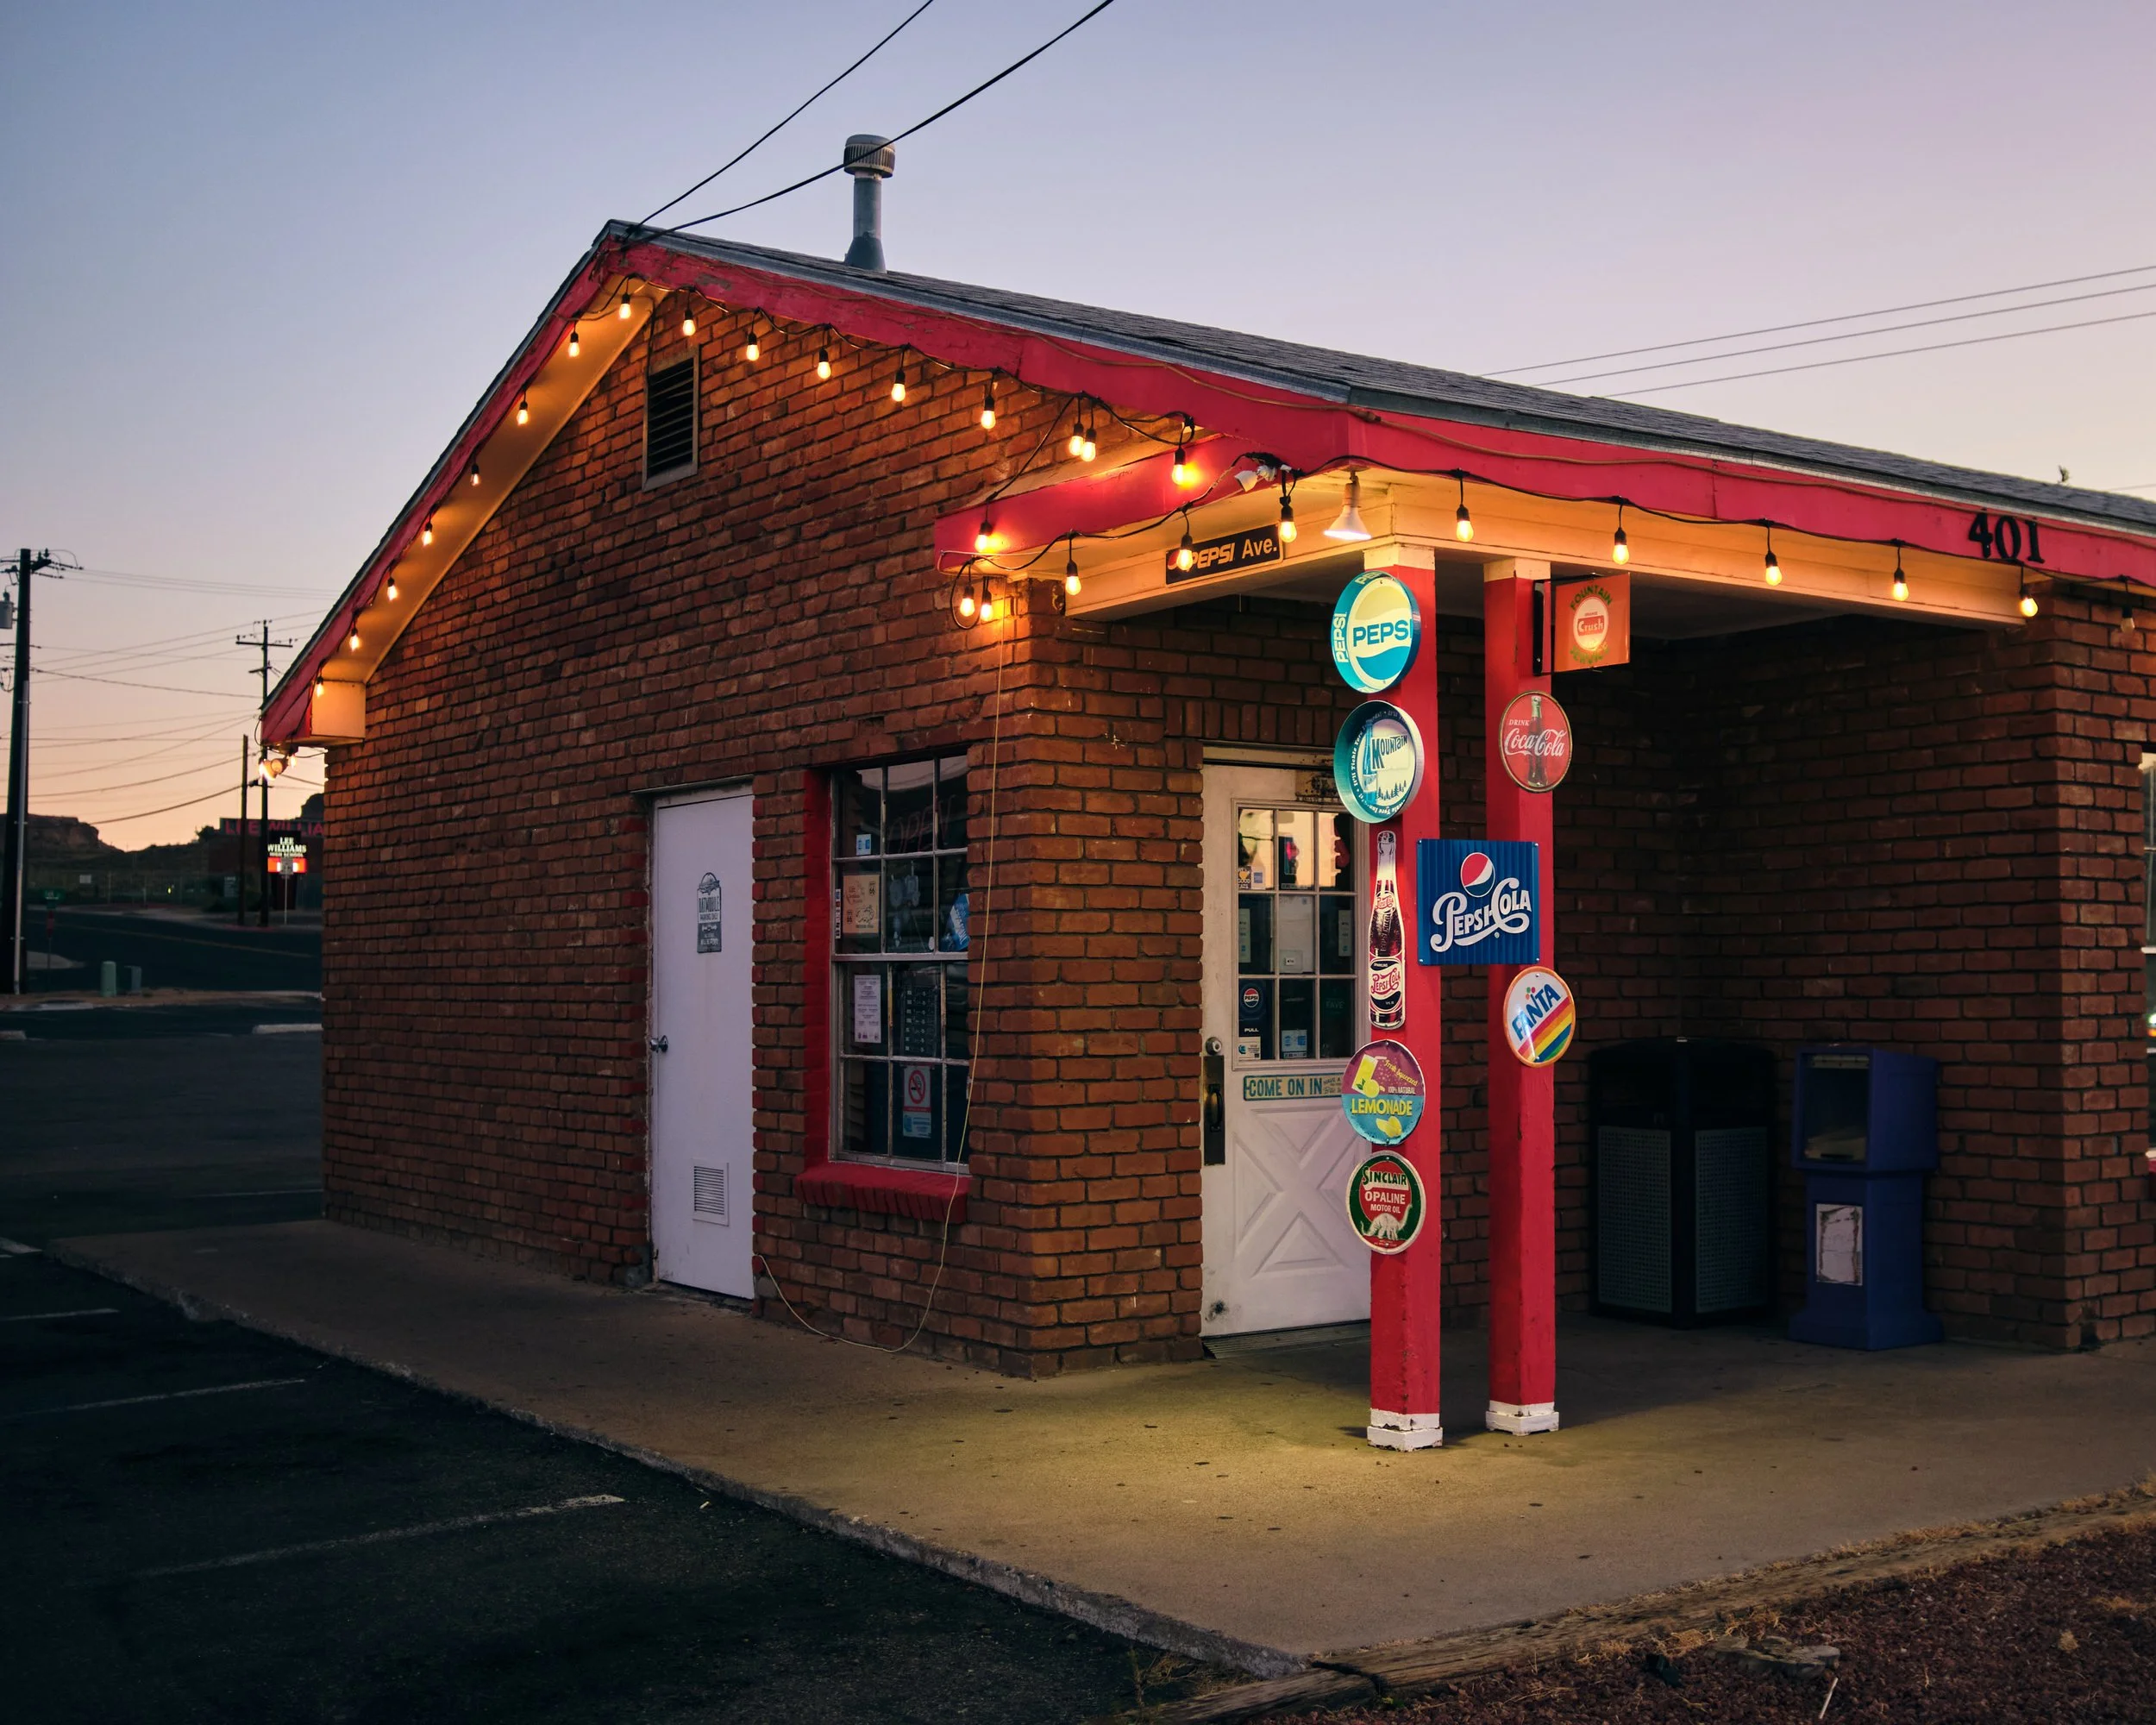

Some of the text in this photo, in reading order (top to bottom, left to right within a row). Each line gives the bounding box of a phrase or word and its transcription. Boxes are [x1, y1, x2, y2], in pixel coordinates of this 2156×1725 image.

[1242, 537, 1277, 559] Ave.
[1969, 512, 2045, 564] 401
[1570, 585, 1612, 611] FOUNTAIN
[1352, 618, 1413, 648] PEPSI
[1577, 618, 1604, 633] Crush
[1332, 612, 1348, 663] PEPSI
[1504, 728, 1567, 757] Coca-Cola
[267, 844, 307, 853] WILLIAMS
[1512, 983, 1562, 1041] FANTA
[1250, 1078, 1282, 1096] COME
[1288, 1078, 1304, 1095] ON
[1309, 1077, 1322, 1095] IN
[1351, 1097, 1413, 1117] LEMONADE
[1363, 1166, 1407, 1186] SINCLAIR
[1364, 1191, 1406, 1205] OPALINE
[1370, 1203, 1401, 1214] MOTOR OIL
